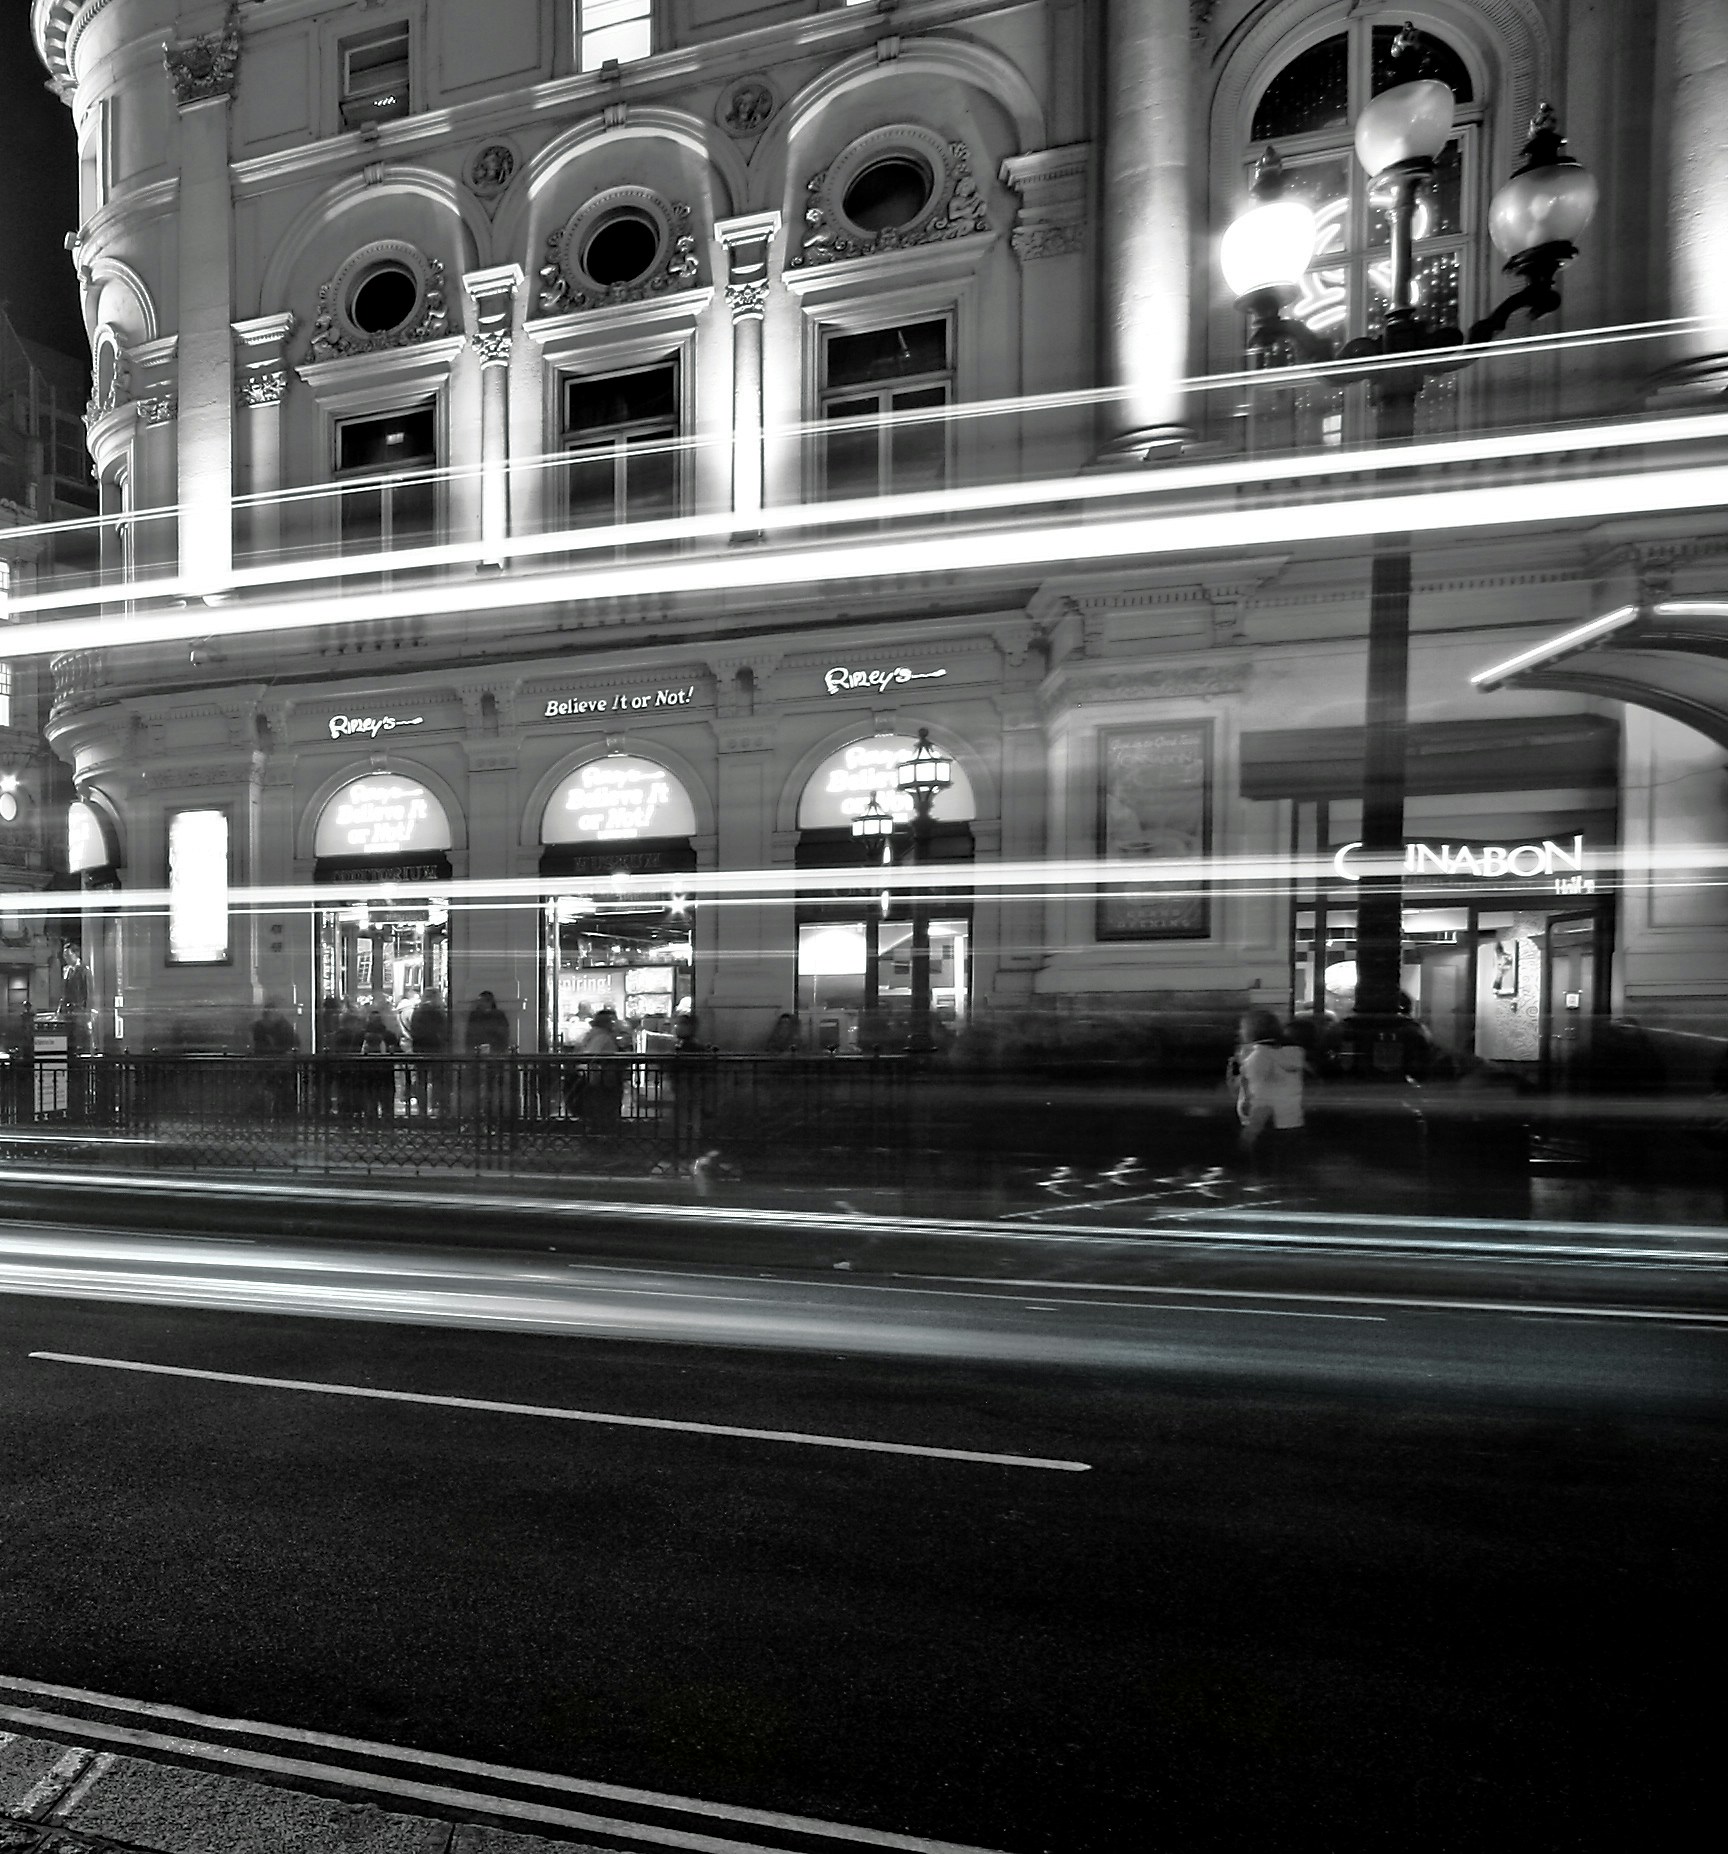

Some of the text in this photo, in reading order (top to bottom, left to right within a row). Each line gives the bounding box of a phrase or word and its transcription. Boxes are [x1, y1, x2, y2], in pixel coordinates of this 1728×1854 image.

[545, 685, 694, 717] Believe It or Not!
